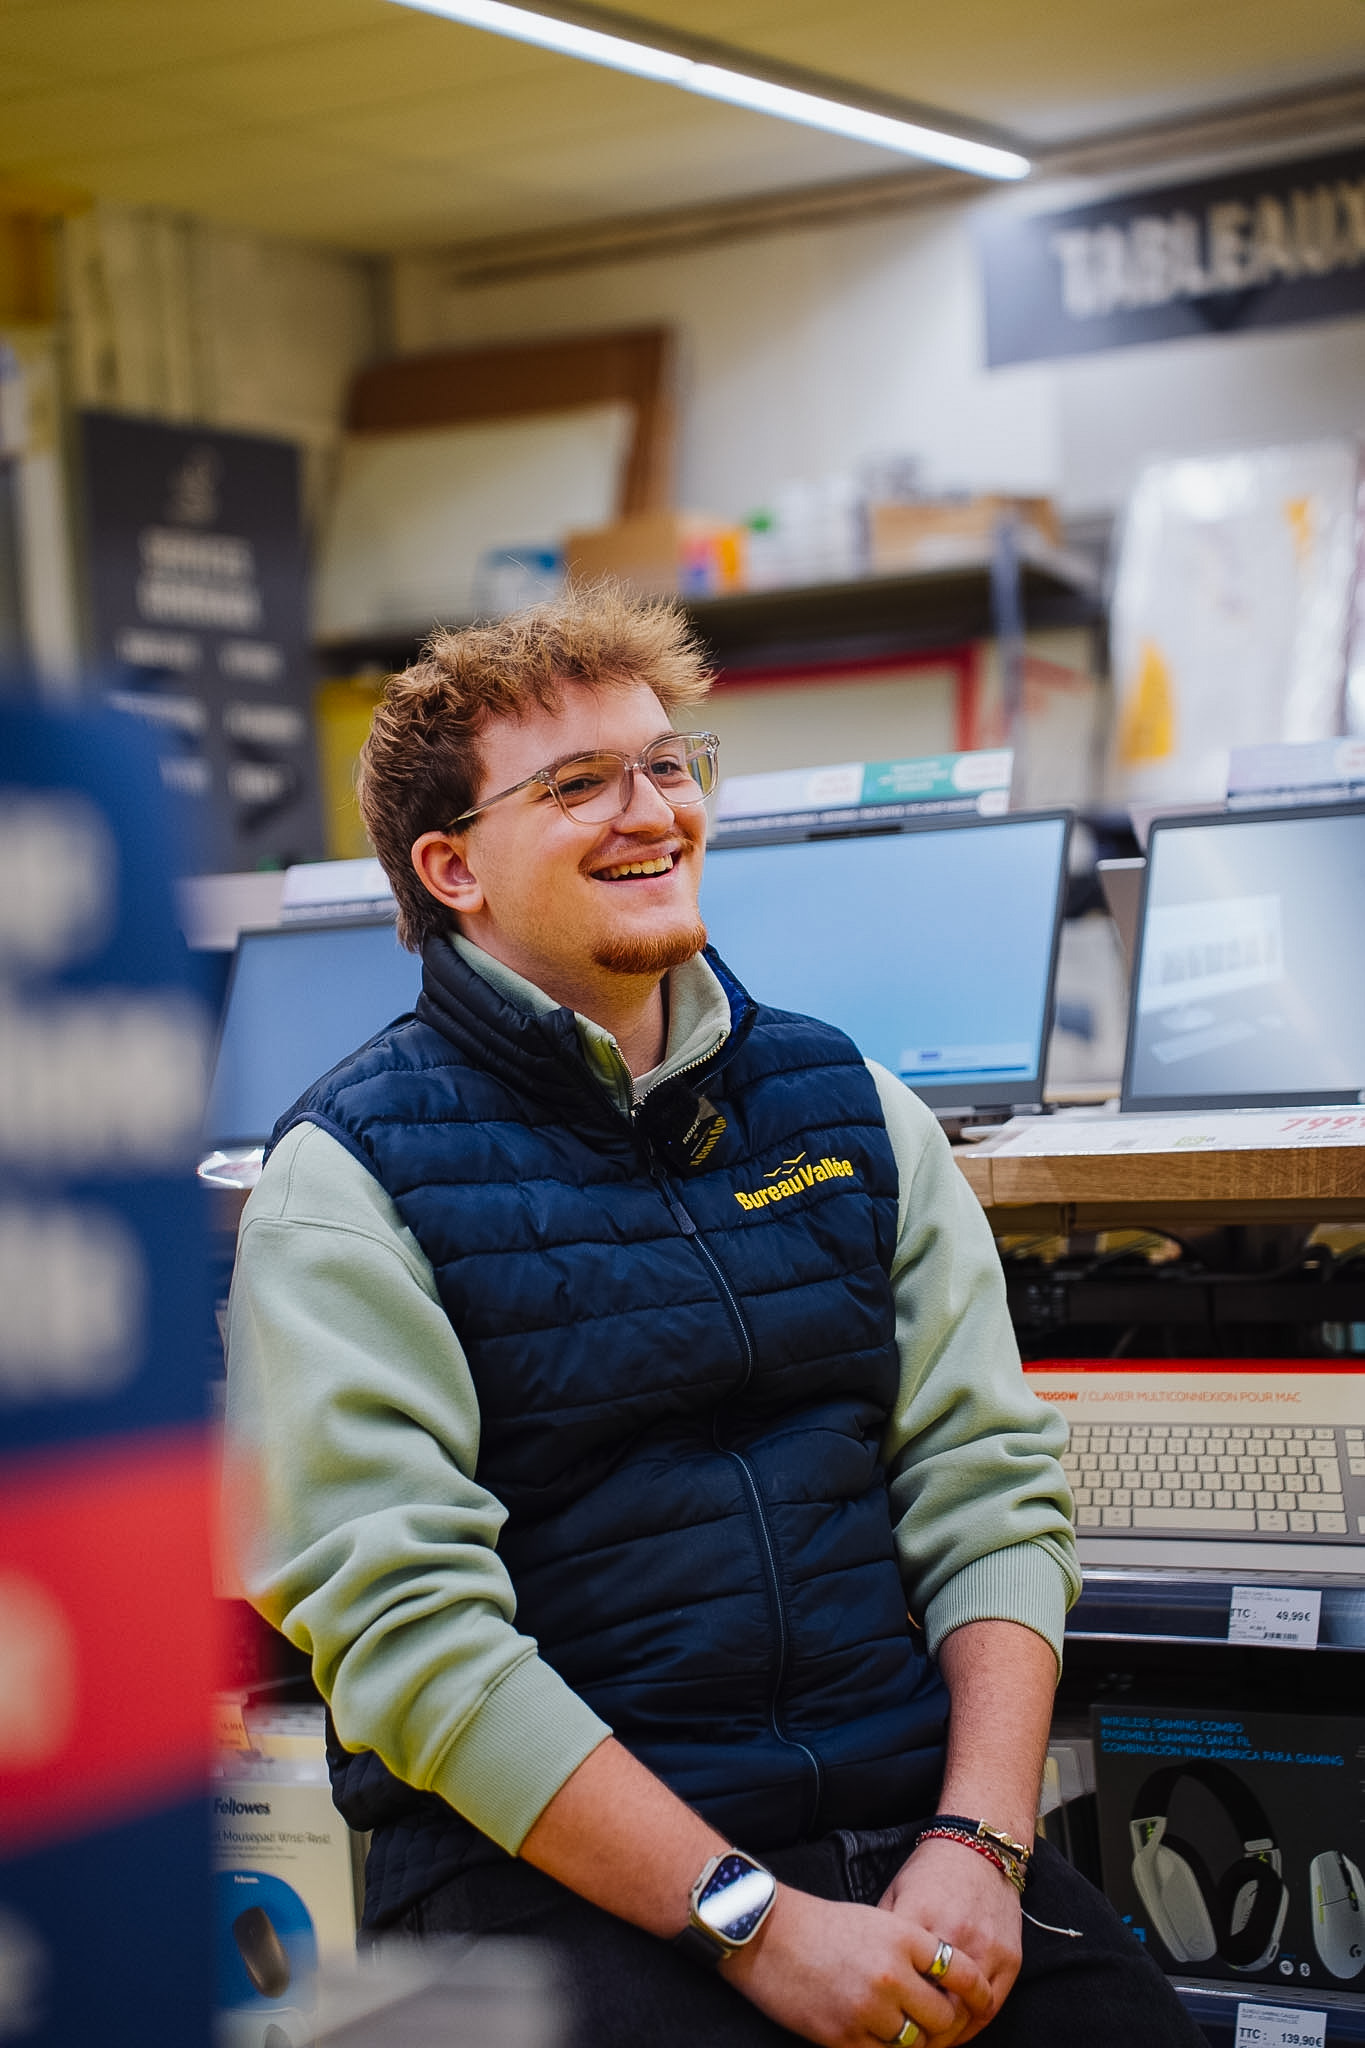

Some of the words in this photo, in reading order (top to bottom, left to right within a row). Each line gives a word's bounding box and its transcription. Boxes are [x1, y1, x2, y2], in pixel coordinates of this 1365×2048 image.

[799, 1156, 854, 1188] Vallée
[1088, 1391, 1134, 1402] CLAVIER
[1137, 1391, 1237, 1402] MULTICONNEXION
[1240, 1391, 1273, 1402] POUR
[1276, 1391, 1302, 1402] MAC
[1276, 1611, 1312, 1622] 49,99€
[1152, 1718, 1199, 1731] GAMING
[1200, 1721, 1244, 1734] COMBO
[1101, 1729, 1155, 1742] ENSEMBLE
[1157, 1731, 1203, 1745] GAMING
[1206, 1734, 1234, 1746] SANS
[1263, 1750, 1293, 1763] PARA
[1295, 1753, 1344, 1766] GAMING
[1239, 2027, 1261, 2039] TTC
[1280, 2032, 1323, 2047] 139,90€
